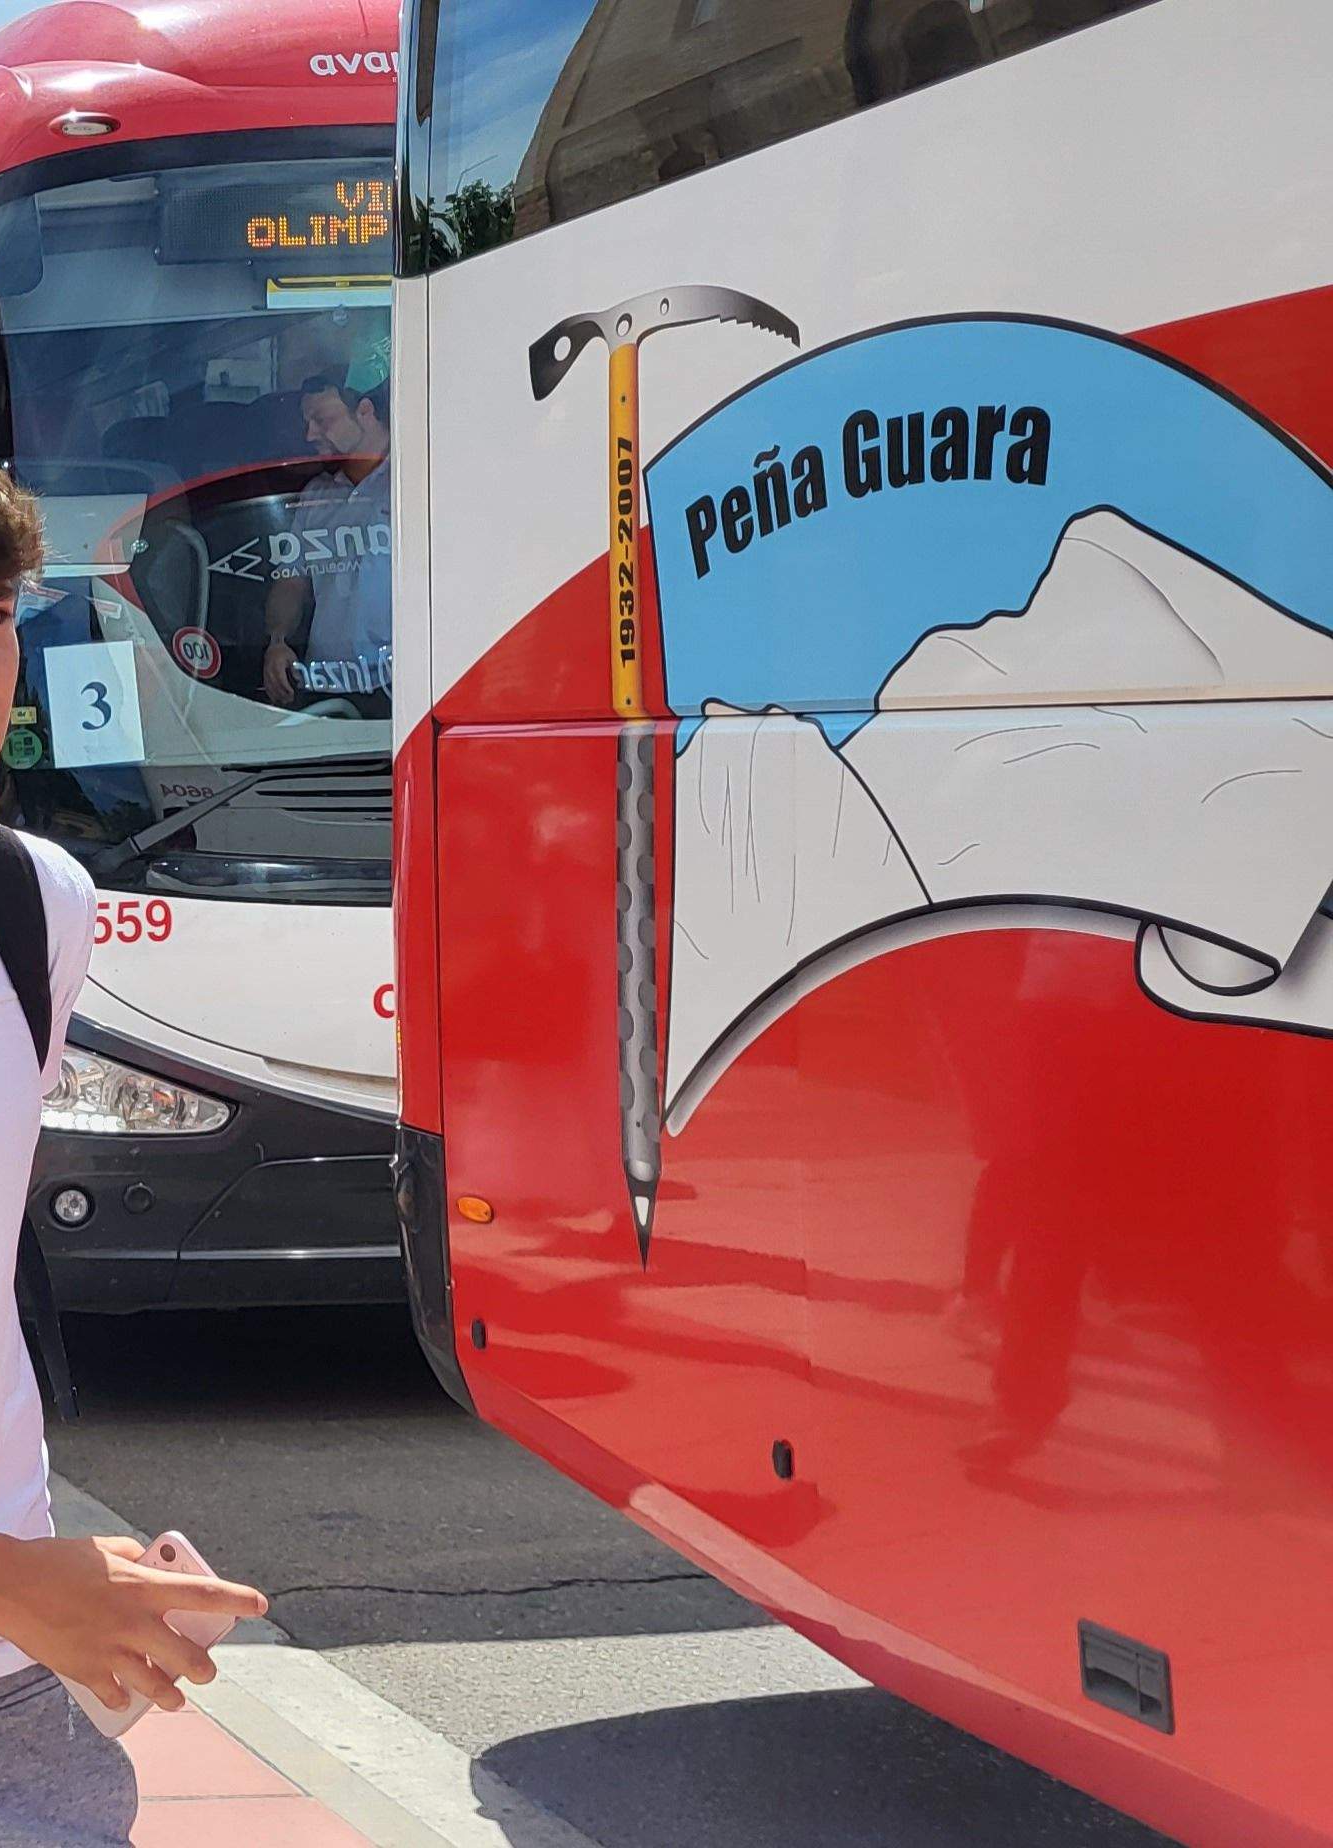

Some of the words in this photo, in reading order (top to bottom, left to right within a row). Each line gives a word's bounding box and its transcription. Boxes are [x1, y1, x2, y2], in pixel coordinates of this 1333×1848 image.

[336, 181, 392, 212] VI
[247, 214, 388, 248] OLIMP
[685, 444, 829, 581] Peña
[841, 403, 1052, 500] Guara
[617, 436, 636, 669] 1932-2007
[80, 681, 112, 731] 3
